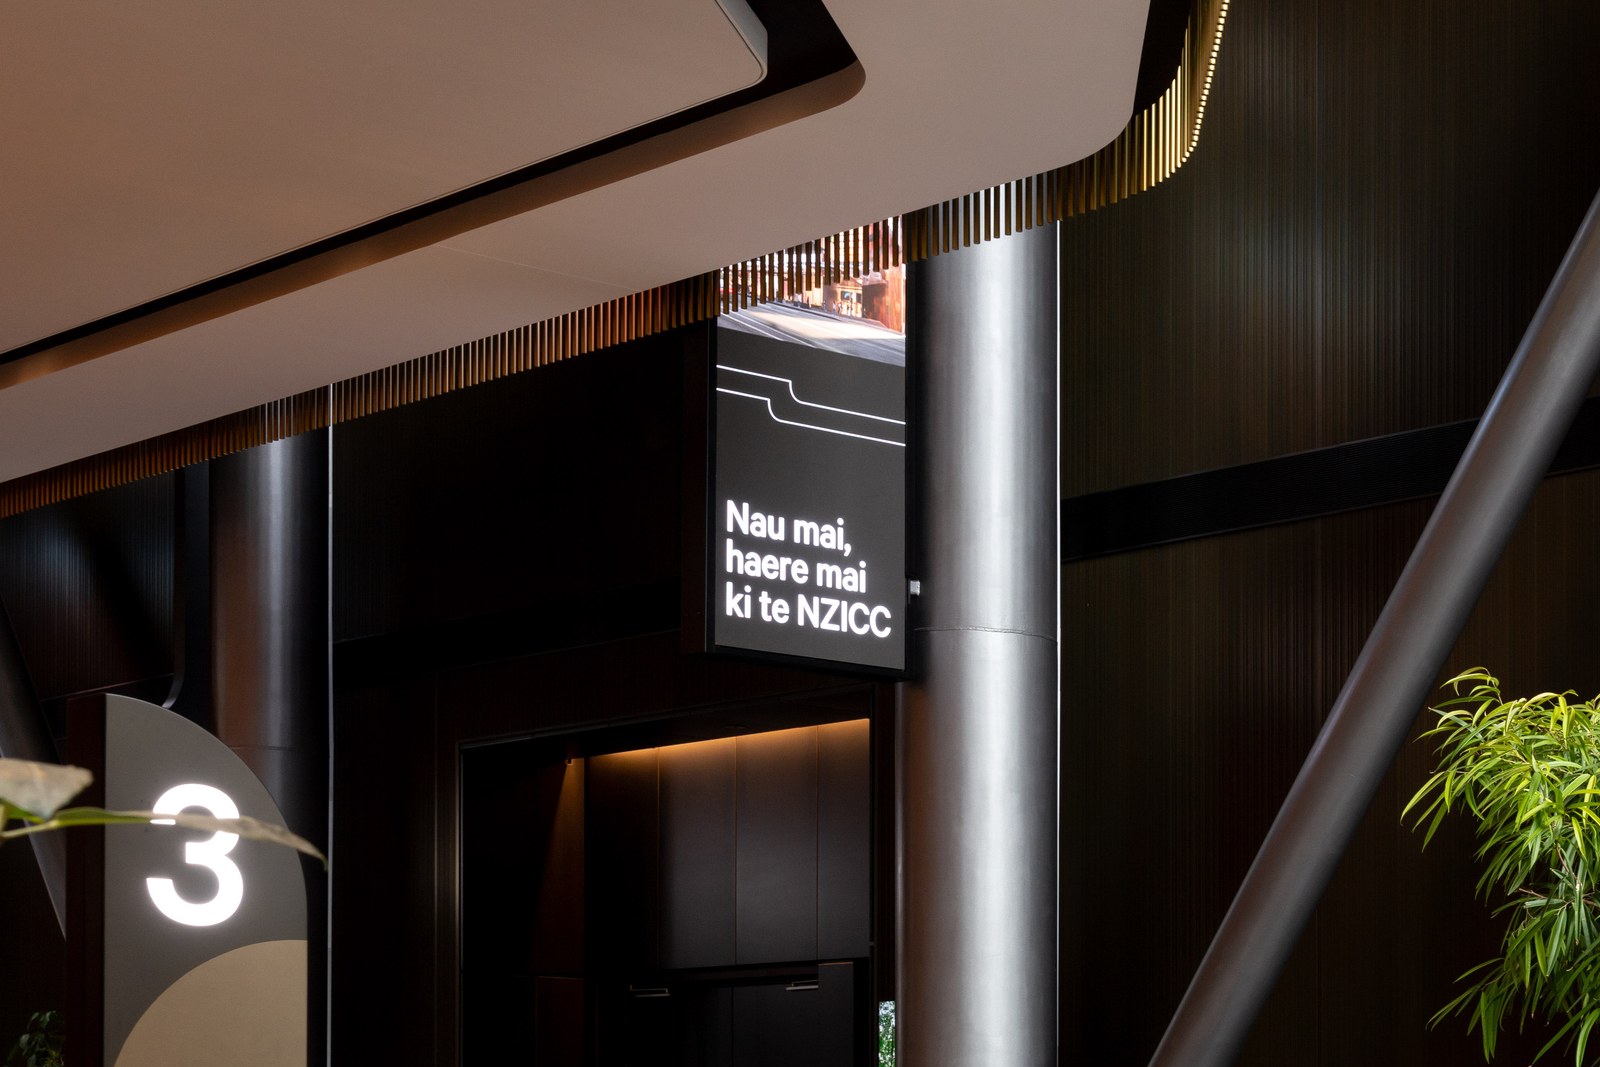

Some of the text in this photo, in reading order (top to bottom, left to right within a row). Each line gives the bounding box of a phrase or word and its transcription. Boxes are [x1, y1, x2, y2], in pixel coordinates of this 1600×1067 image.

[725, 499, 853, 557] Nau mai,
[725, 538, 867, 594] haere mai
[725, 581, 892, 639] ki te NZICC
[145, 782, 244, 927] 3
